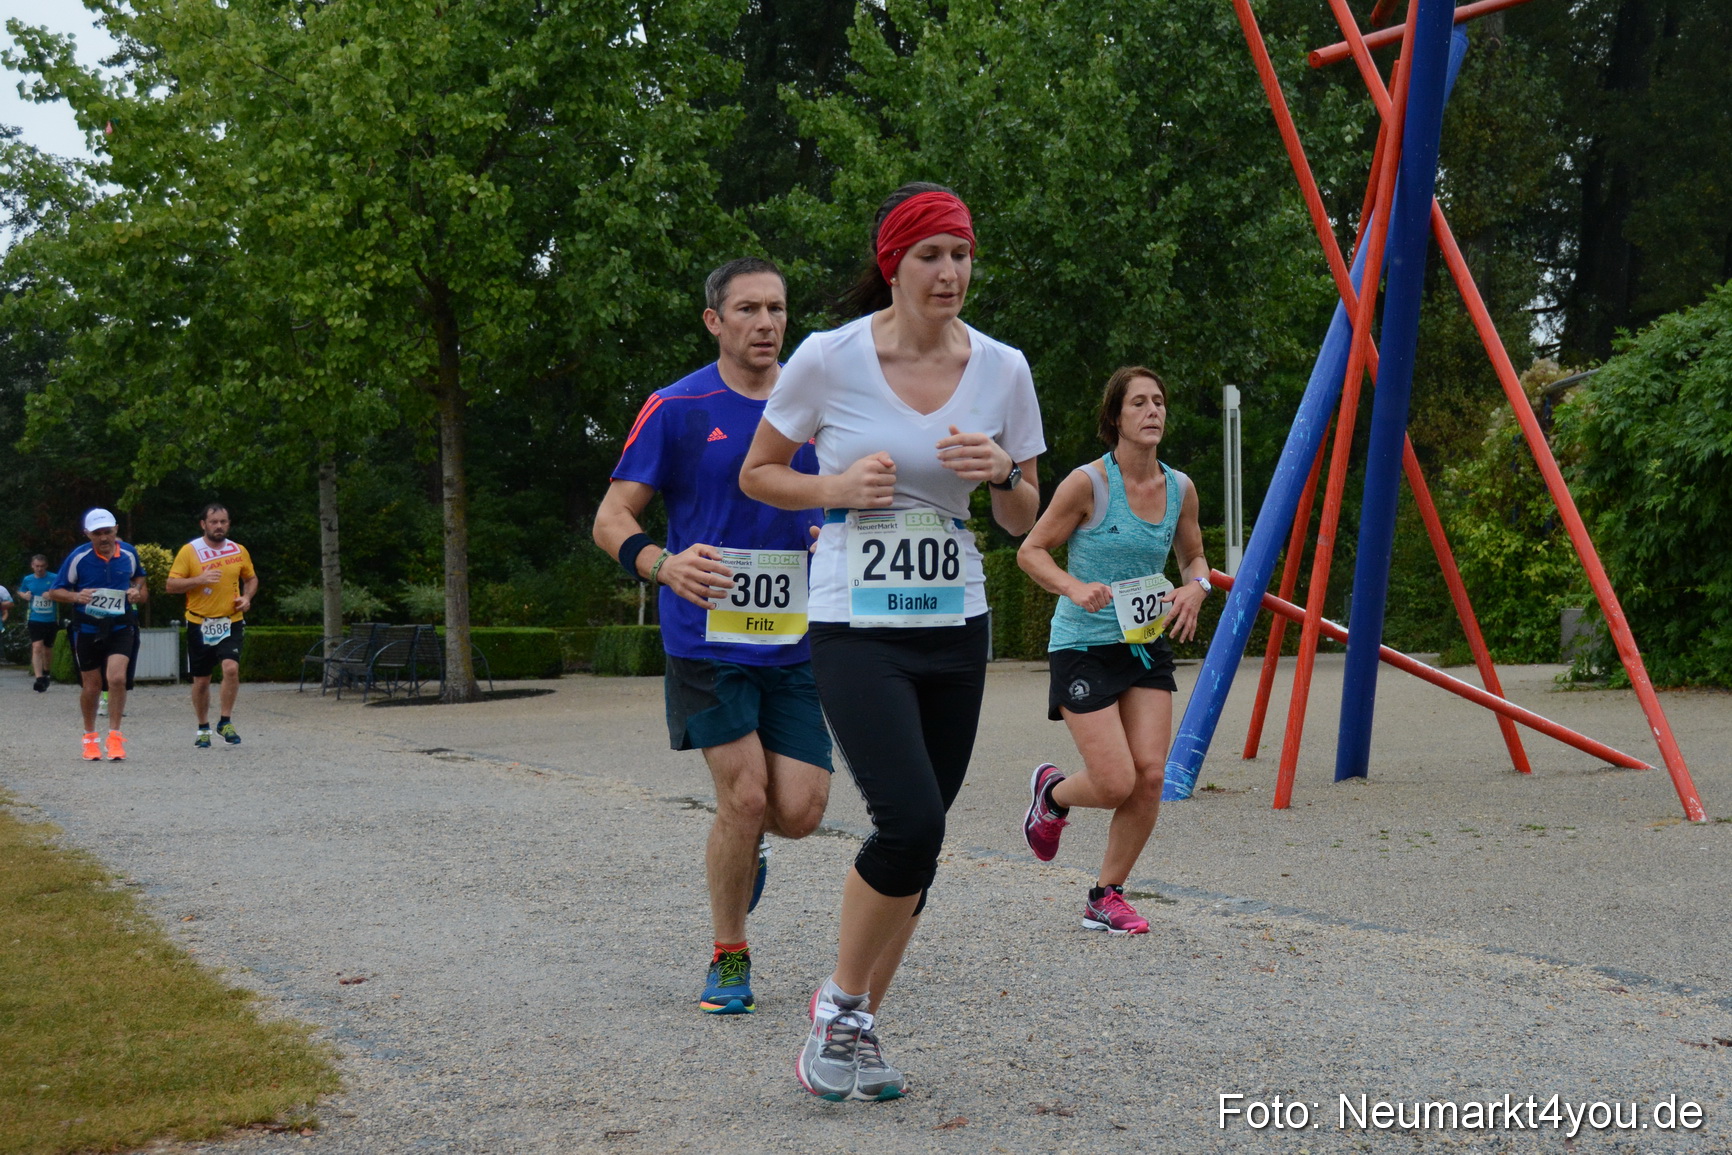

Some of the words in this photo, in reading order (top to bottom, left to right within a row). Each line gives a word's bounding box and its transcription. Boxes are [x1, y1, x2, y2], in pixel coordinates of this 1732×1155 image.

[857, 522, 898, 532] NeuerMarkt
[758, 553, 801, 566] BOCK
[862, 538, 960, 581] 2408
[853, 578, 860, 587] D
[731, 572, 791, 609] 303
[91, 595, 122, 611] 2274
[888, 593, 938, 611] Bianka
[1131, 591, 1166, 625] 327
[203, 622, 229, 636] 2686
[746, 617, 775, 631] Fritz
[1143, 627, 1157, 640] Lisa
